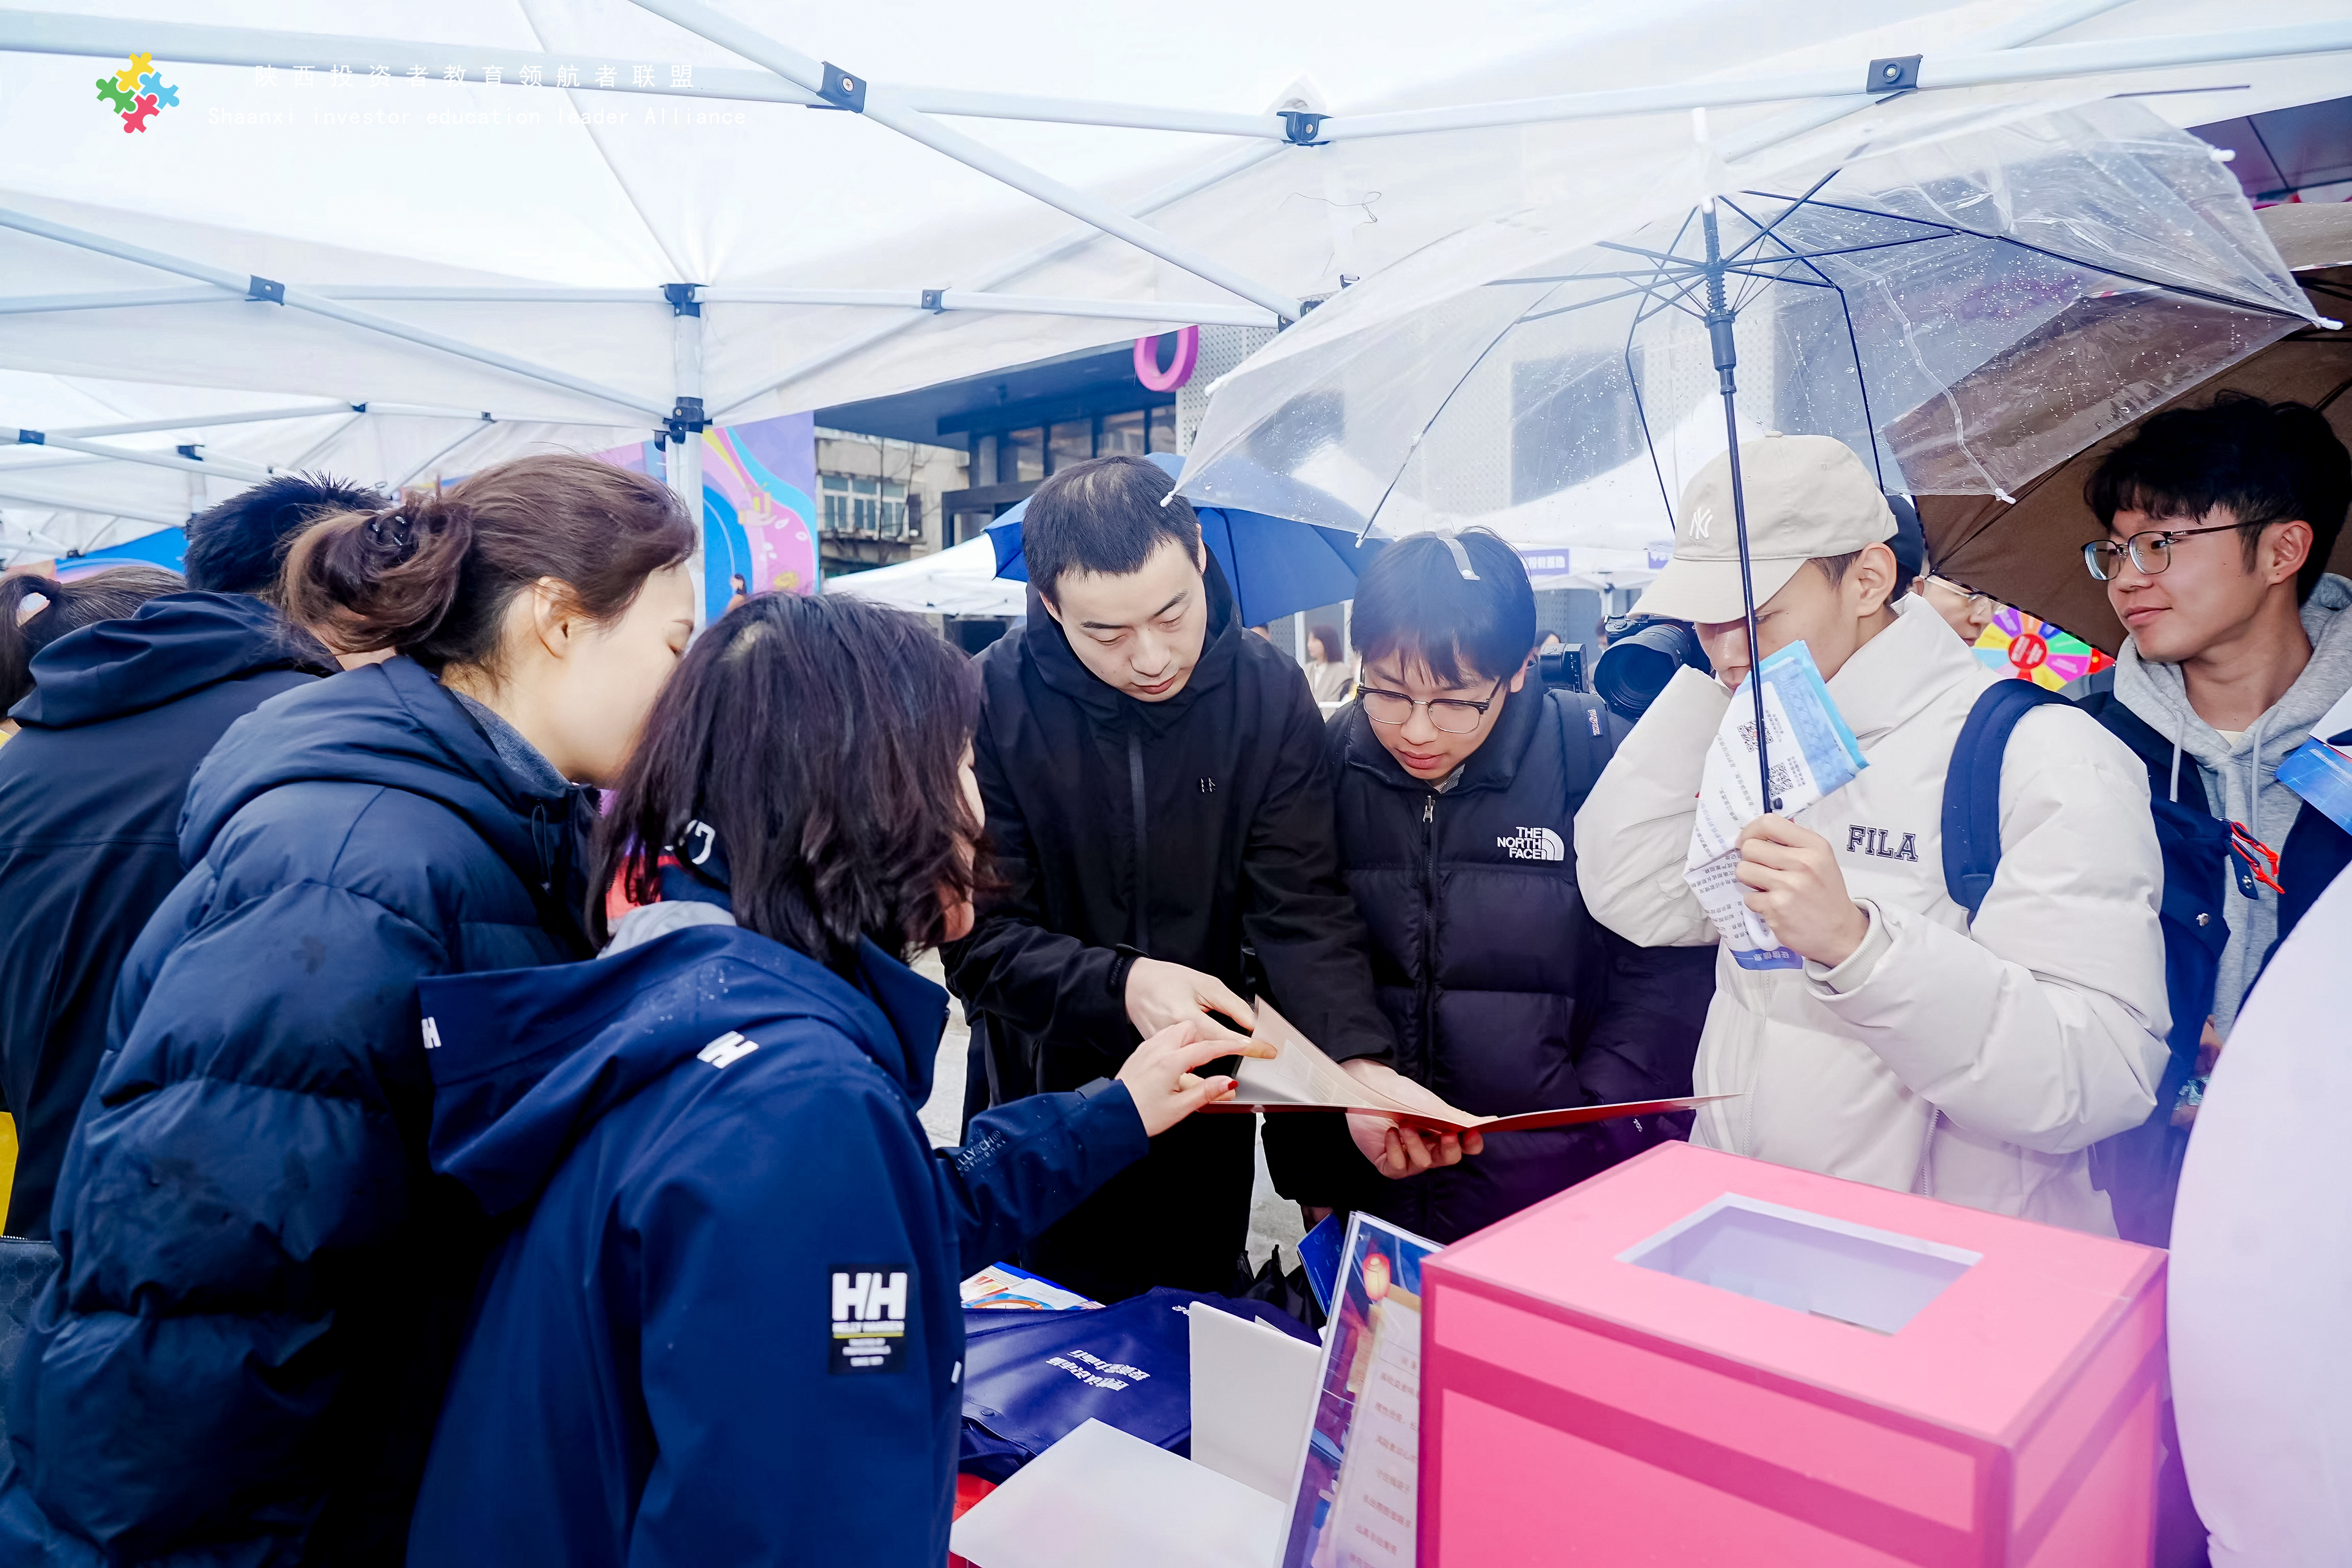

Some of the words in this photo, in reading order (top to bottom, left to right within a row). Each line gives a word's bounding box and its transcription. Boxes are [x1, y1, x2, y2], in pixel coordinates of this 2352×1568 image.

[1515, 826, 1542, 839] THE
[1497, 837, 1542, 849] NORTH
[1847, 824, 1919, 863] FILA
[1509, 848, 1542, 860] FACE
[831, 1272, 908, 1320] HH
